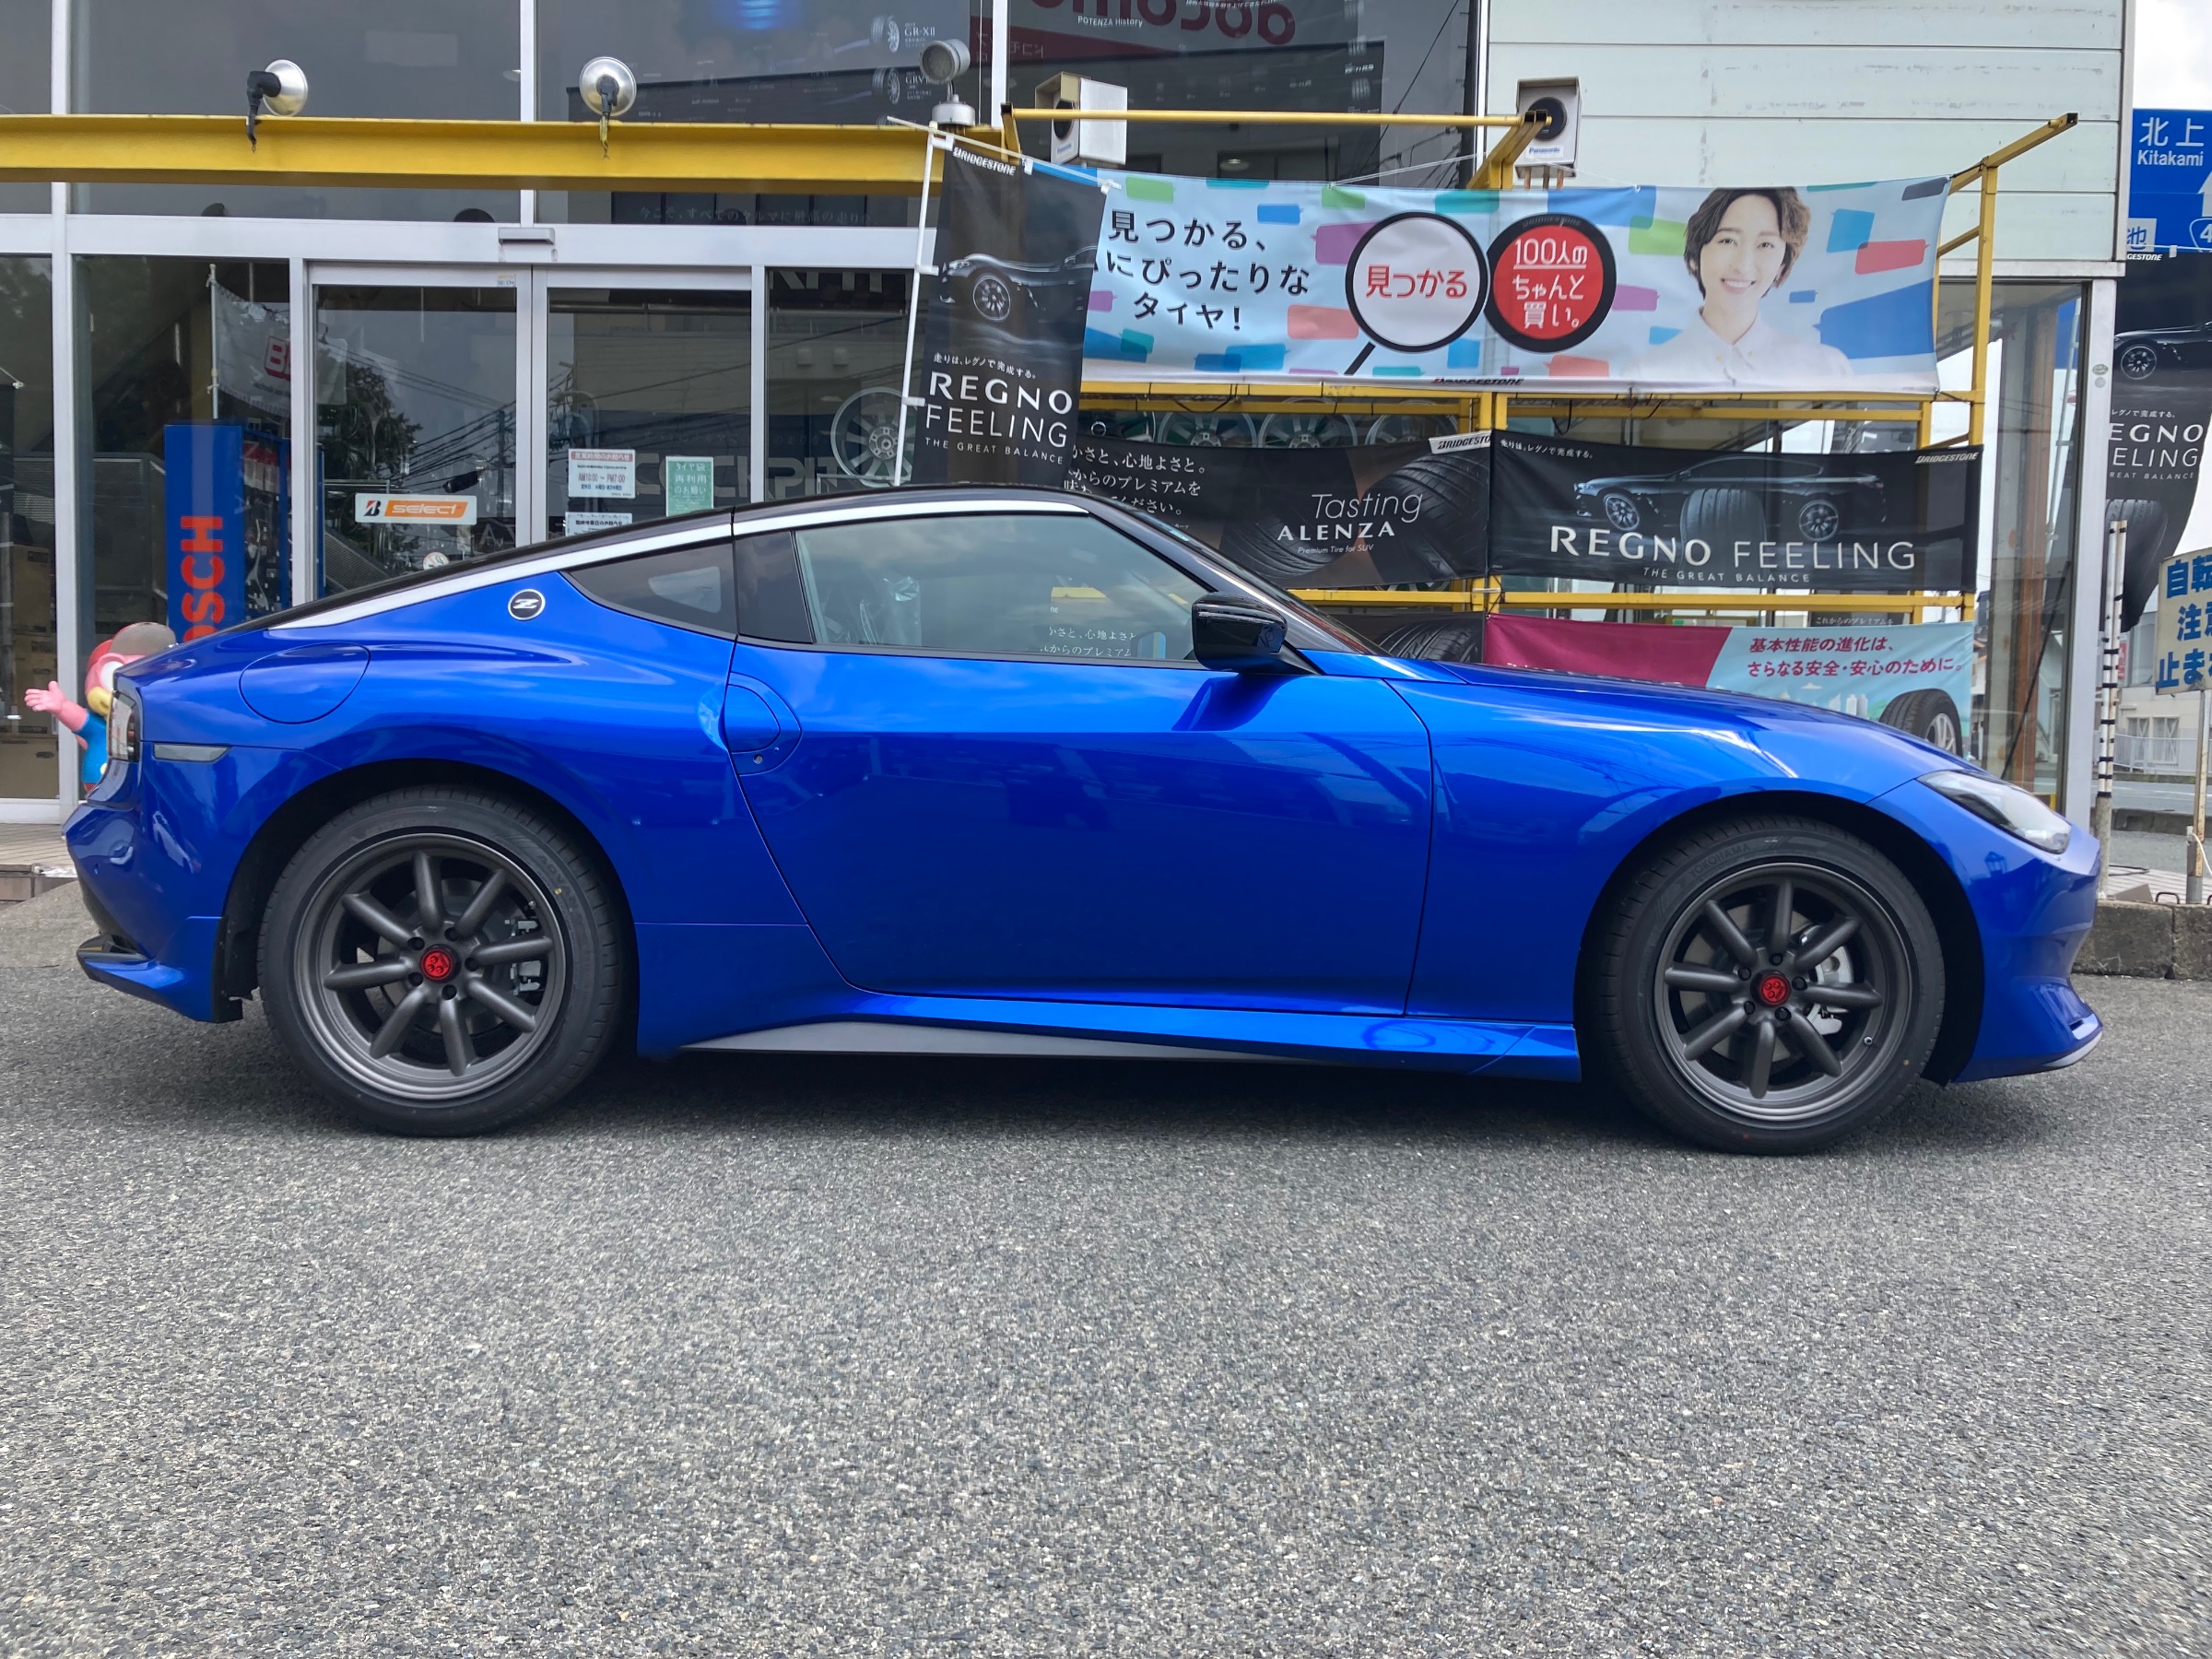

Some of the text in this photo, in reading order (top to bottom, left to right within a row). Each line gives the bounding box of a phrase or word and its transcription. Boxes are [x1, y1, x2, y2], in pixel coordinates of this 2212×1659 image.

[1077, 15, 1143, 29] POTENZA History
[2139, 117, 2205, 147] 北上
[953, 147, 1017, 176] BRIDGESTONE
[2137, 149, 2204, 167] Kitakami
[1108, 208, 1265, 252] 見つかる、
[1514, 238, 1588, 266] 100人の
[1094, 250, 1311, 296] にぴったりな
[1366, 264, 1468, 300] 見つかる
[1512, 275, 1584, 300] ちゃんと
[1524, 301, 1580, 329] 買い。
[933, 352, 1037, 380] 走りは、レグノで完成する。
[929, 371, 1073, 415] REGNO
[925, 403, 1068, 448] FEELING
[924, 437, 1063, 465] THE GREAT BALANCE
[1914, 452, 1979, 465] BRIDGESTONE
[675, 474, 707, 484] 再利用
[392, 503, 457, 514] select
[1312, 493, 1423, 524] Tasting
[1277, 521, 1395, 541] ALENZA
[1358, 544, 1374, 552] SUV
[1550, 524, 1915, 570] REGNO FEELING
[1643, 567, 1810, 582] THE GREAT BALANCE
[1749, 636, 1895, 653] 基本性能の進化は、
[1747, 657, 1963, 678] さらなる安全・安心のために。
[2156, 648, 2212, 689] 止ま
[1689, 842, 1751, 877] YOKOHAMA
